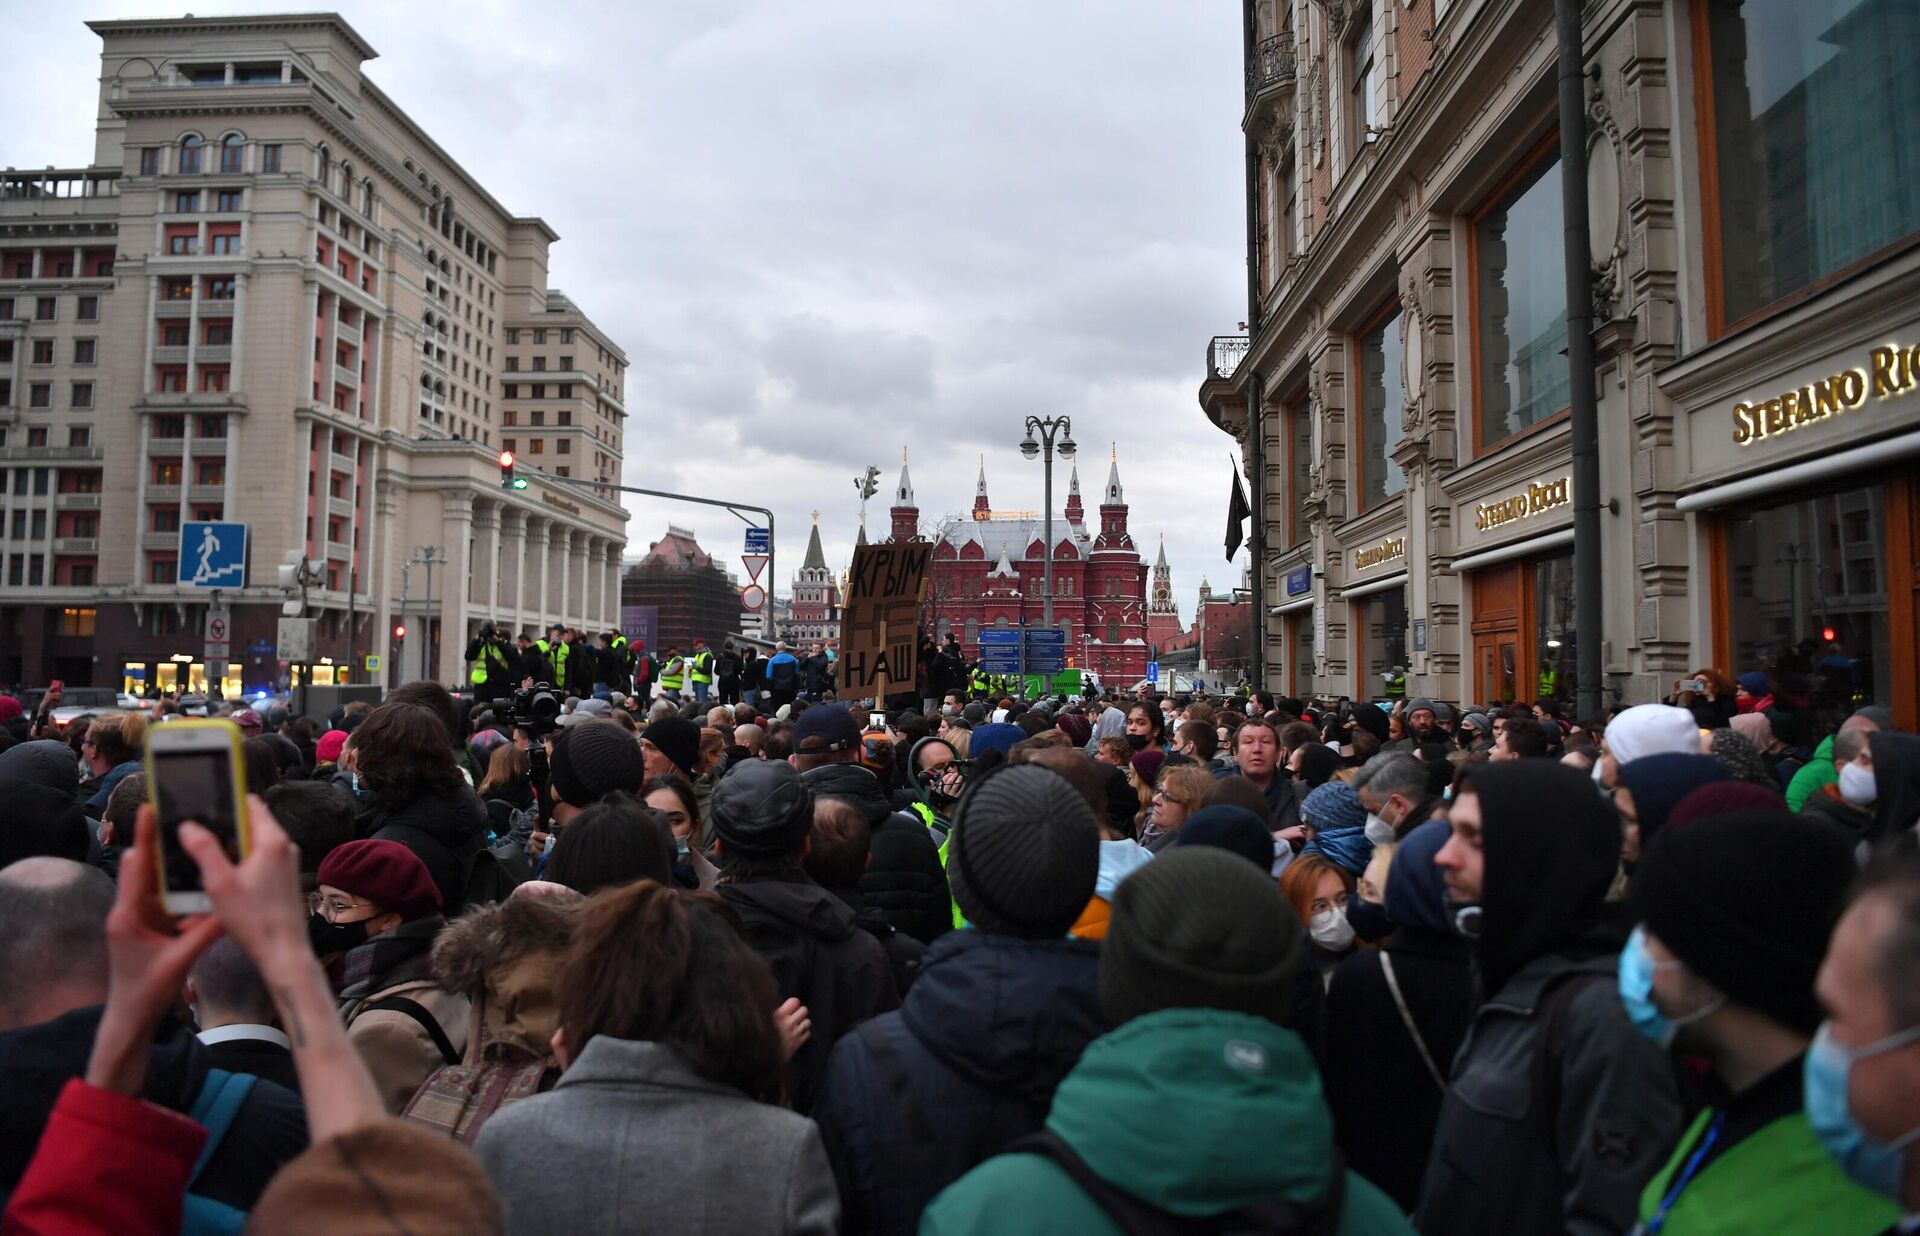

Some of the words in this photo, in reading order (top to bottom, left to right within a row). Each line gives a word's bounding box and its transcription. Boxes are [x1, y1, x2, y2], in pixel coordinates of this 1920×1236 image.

[1733, 369, 1867, 443] STEFANO
[852, 548, 929, 598] КРЫМ
[845, 600, 915, 650] НЕ
[844, 643, 912, 689] НАШ
